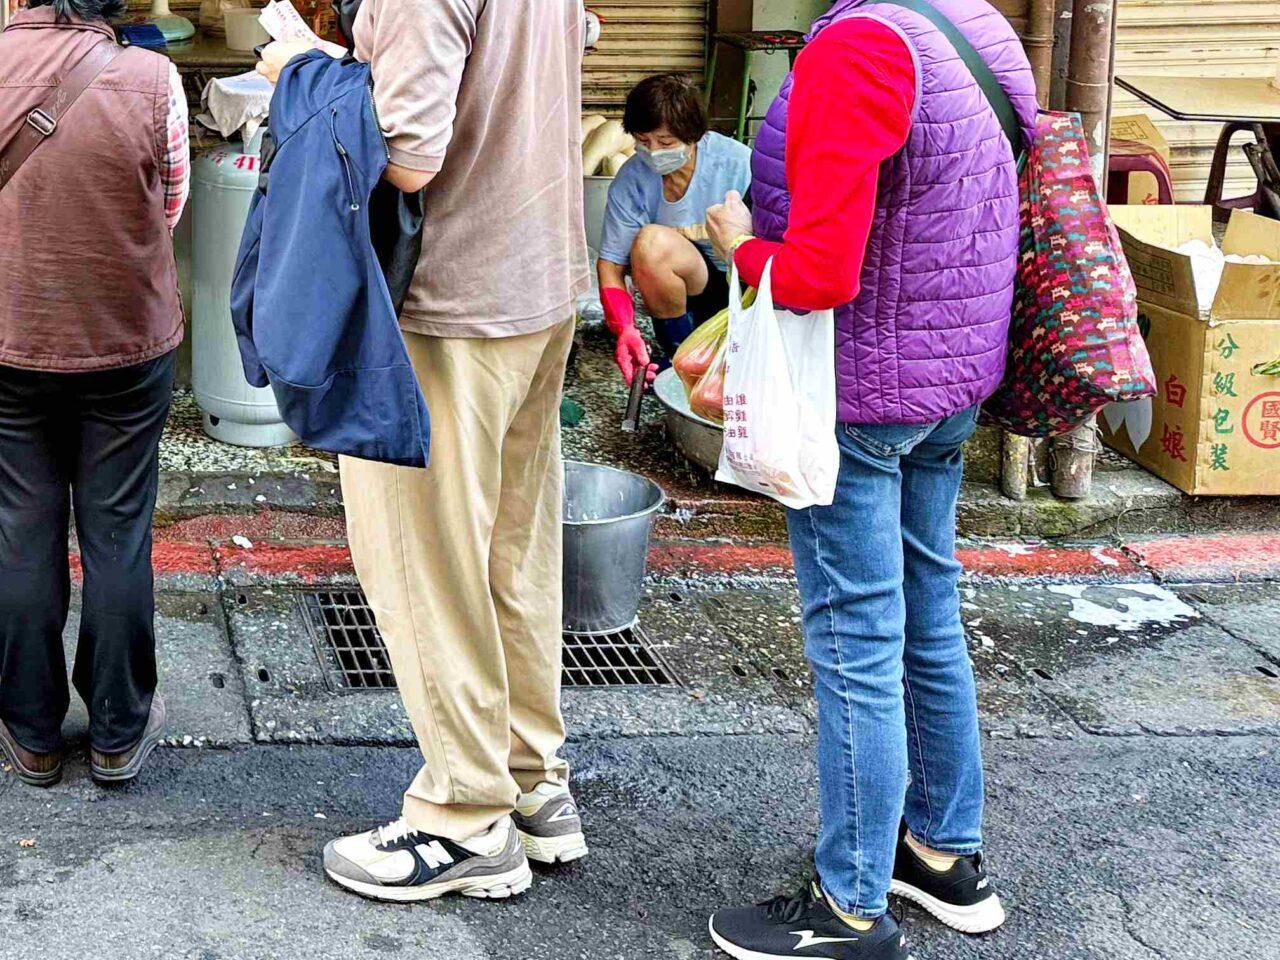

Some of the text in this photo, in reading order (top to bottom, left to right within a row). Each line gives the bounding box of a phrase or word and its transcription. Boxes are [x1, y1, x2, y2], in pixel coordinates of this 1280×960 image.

[1160, 374, 1188, 462] 白娘
[1208, 332, 1240, 471] 分級包裝
